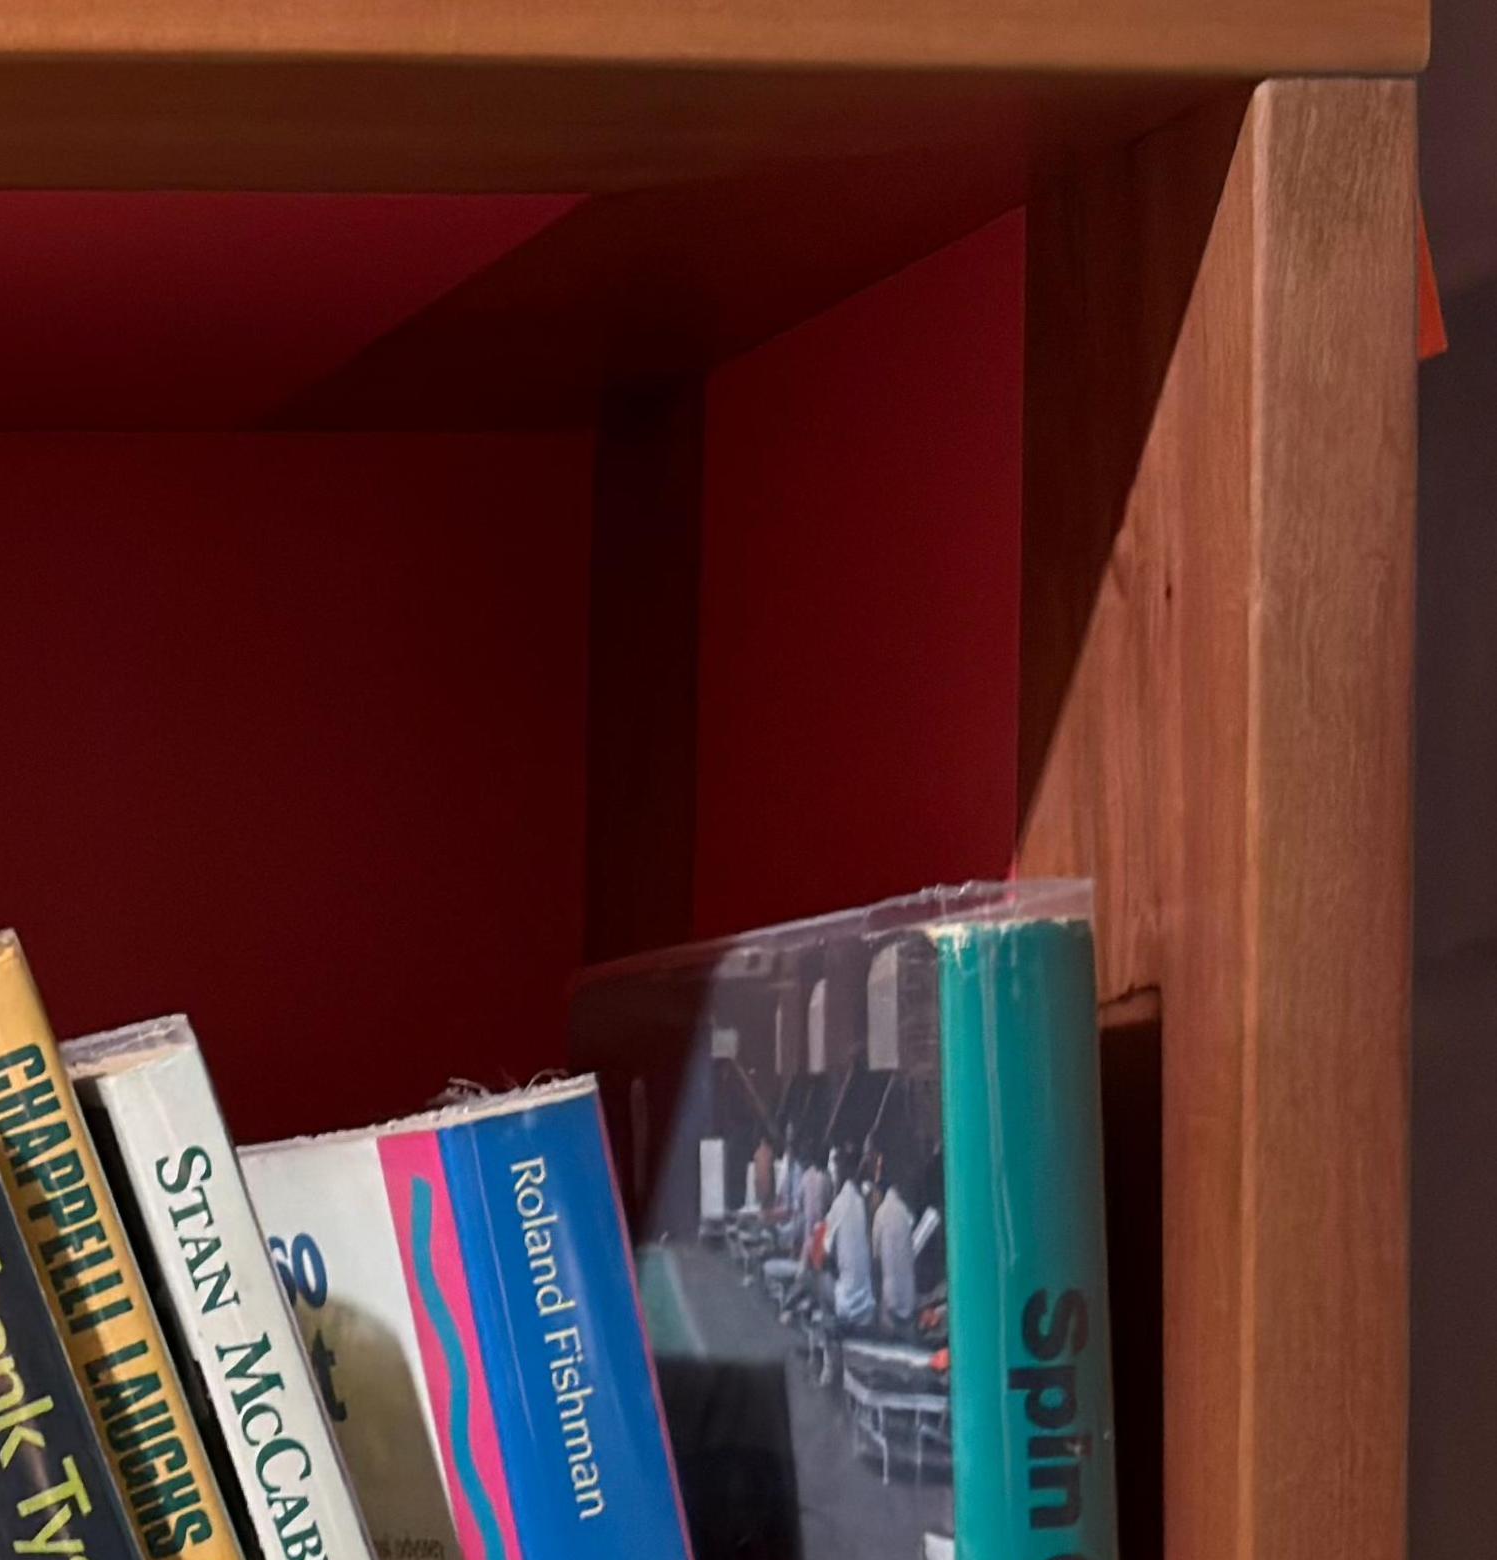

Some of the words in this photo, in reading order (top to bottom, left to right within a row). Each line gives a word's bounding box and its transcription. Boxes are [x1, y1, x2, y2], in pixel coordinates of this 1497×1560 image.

[156, 1144, 240, 1316] STAN
[510, 1156, 562, 1318] Roland
[543, 1323, 606, 1520] Fishman
[85, 1339, 212, 1560] LAUGHS
[1008, 1287, 1093, 1530] Spin
